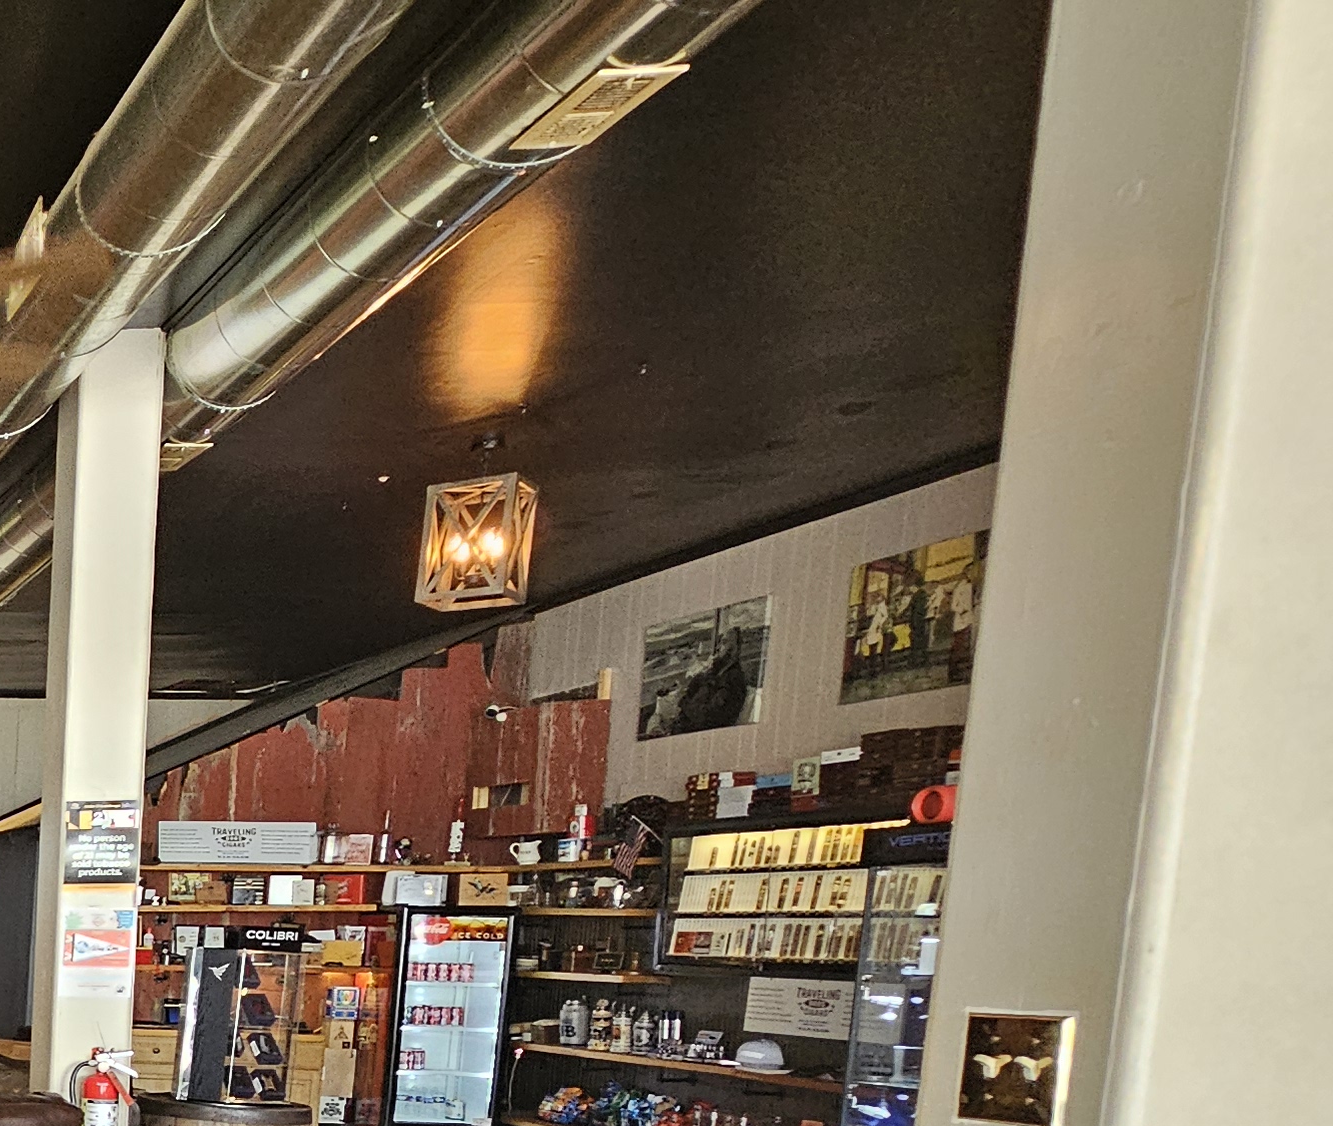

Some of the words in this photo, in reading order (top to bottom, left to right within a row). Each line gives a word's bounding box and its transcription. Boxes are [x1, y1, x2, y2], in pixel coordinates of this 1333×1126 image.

[211, 826, 257, 836] TRAVELING
[93, 834, 126, 843] person
[77, 867, 123, 878] products.
[246, 929, 299, 942] COLIBRI
[475, 932, 505, 940] COLD
[796, 986, 843, 1001] TRAVELING
